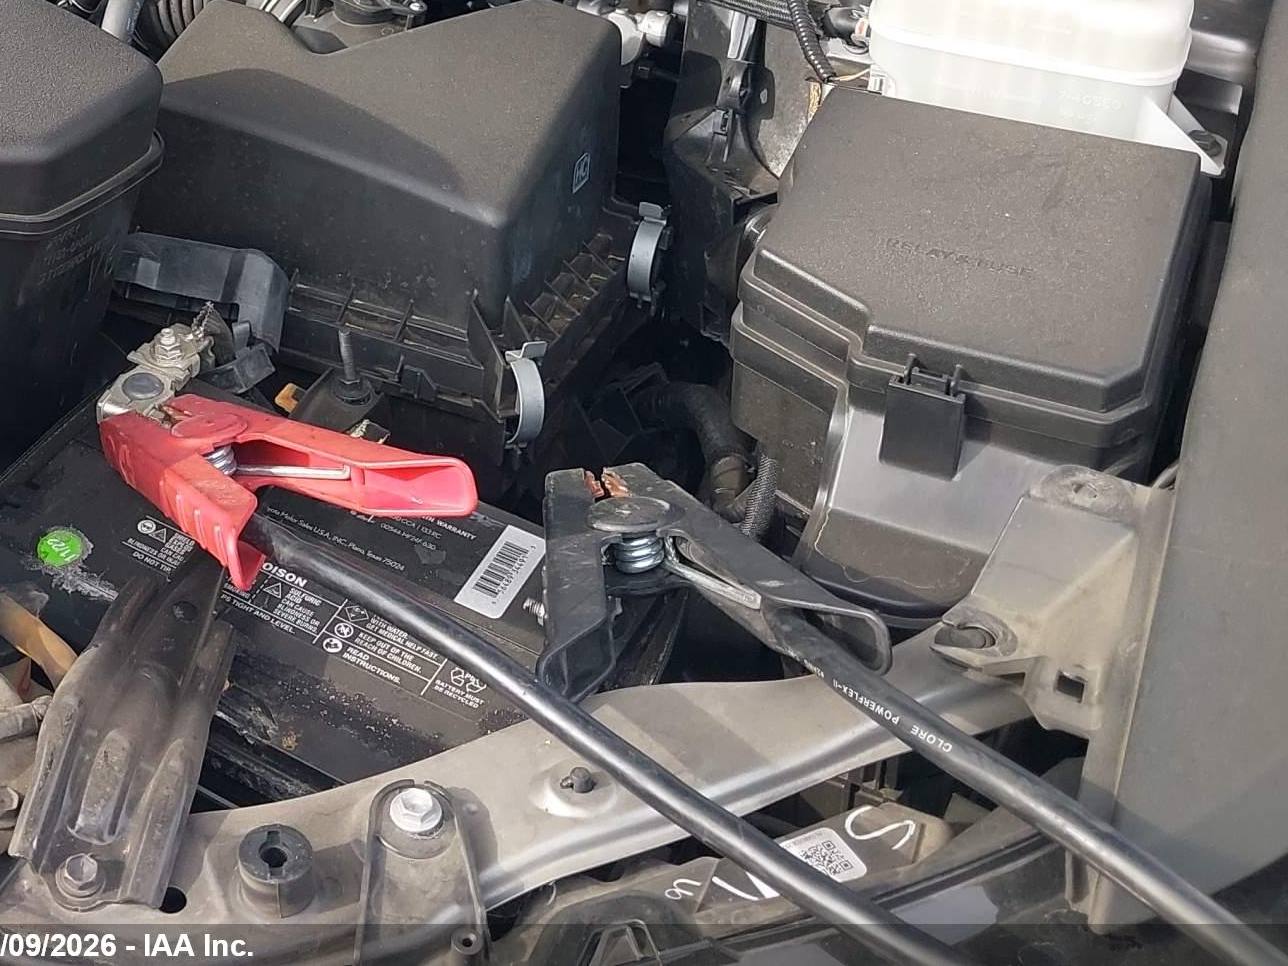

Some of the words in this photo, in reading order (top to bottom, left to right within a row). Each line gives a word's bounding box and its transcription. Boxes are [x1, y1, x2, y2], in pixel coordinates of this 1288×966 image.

[279, 511, 299, 524] Motor
[298, 518, 314, 532] Sales
[365, 550, 382, 562] Texas
[381, 556, 406, 571] 75024
[437, 517, 477, 540] WARRANTY
[127, 537, 158, 556] BLINDNESS
[132, 551, 145, 560] DO
[143, 557, 159, 567] NOT
[262, 562, 308, 588] OISON
[281, 598, 294, 608] CAN
[293, 604, 315, 618] CAUSE
[285, 594, 303, 604] ACID
[289, 587, 322, 607] SULFURIC
[231, 598, 254, 613] TIGHT
[253, 608, 271, 621] AND
[270, 617, 296, 634] LEVEL.
[273, 608, 296, 623] SEVERE
[295, 619, 318, 634] BURNS.
[277, 603, 311, 623] BLINDNESS
[309, 618, 321, 627] OR
[365, 622, 379, 633] GET
[378, 628, 405, 645] MEDICAL
[405, 639, 422, 653] HELP
[420, 646, 440, 660] FAST.
[370, 617, 387, 629] WITH
[386, 624, 410, 640] WATER.
[346, 646, 370, 661] READ
[354, 637, 378, 654] REACH
[377, 648, 388, 657] OF
[386, 652, 422, 674] CHILDREN.
[358, 632, 377, 643] KEEP
[376, 639, 391, 650] OUT
[390, 646, 401, 655] OF
[400, 650, 415, 662] THE
[342, 652, 401, 684] INSTRUCTIONS.
[434, 685, 444, 693] BE
[443, 689, 479, 709] RECYCLED
[435, 679, 466, 696] BATTERY
[464, 693, 485, 705] MUST
[832, 677, 900, 725] POWERFLEX-II
[909, 724, 953, 753] CLORE
